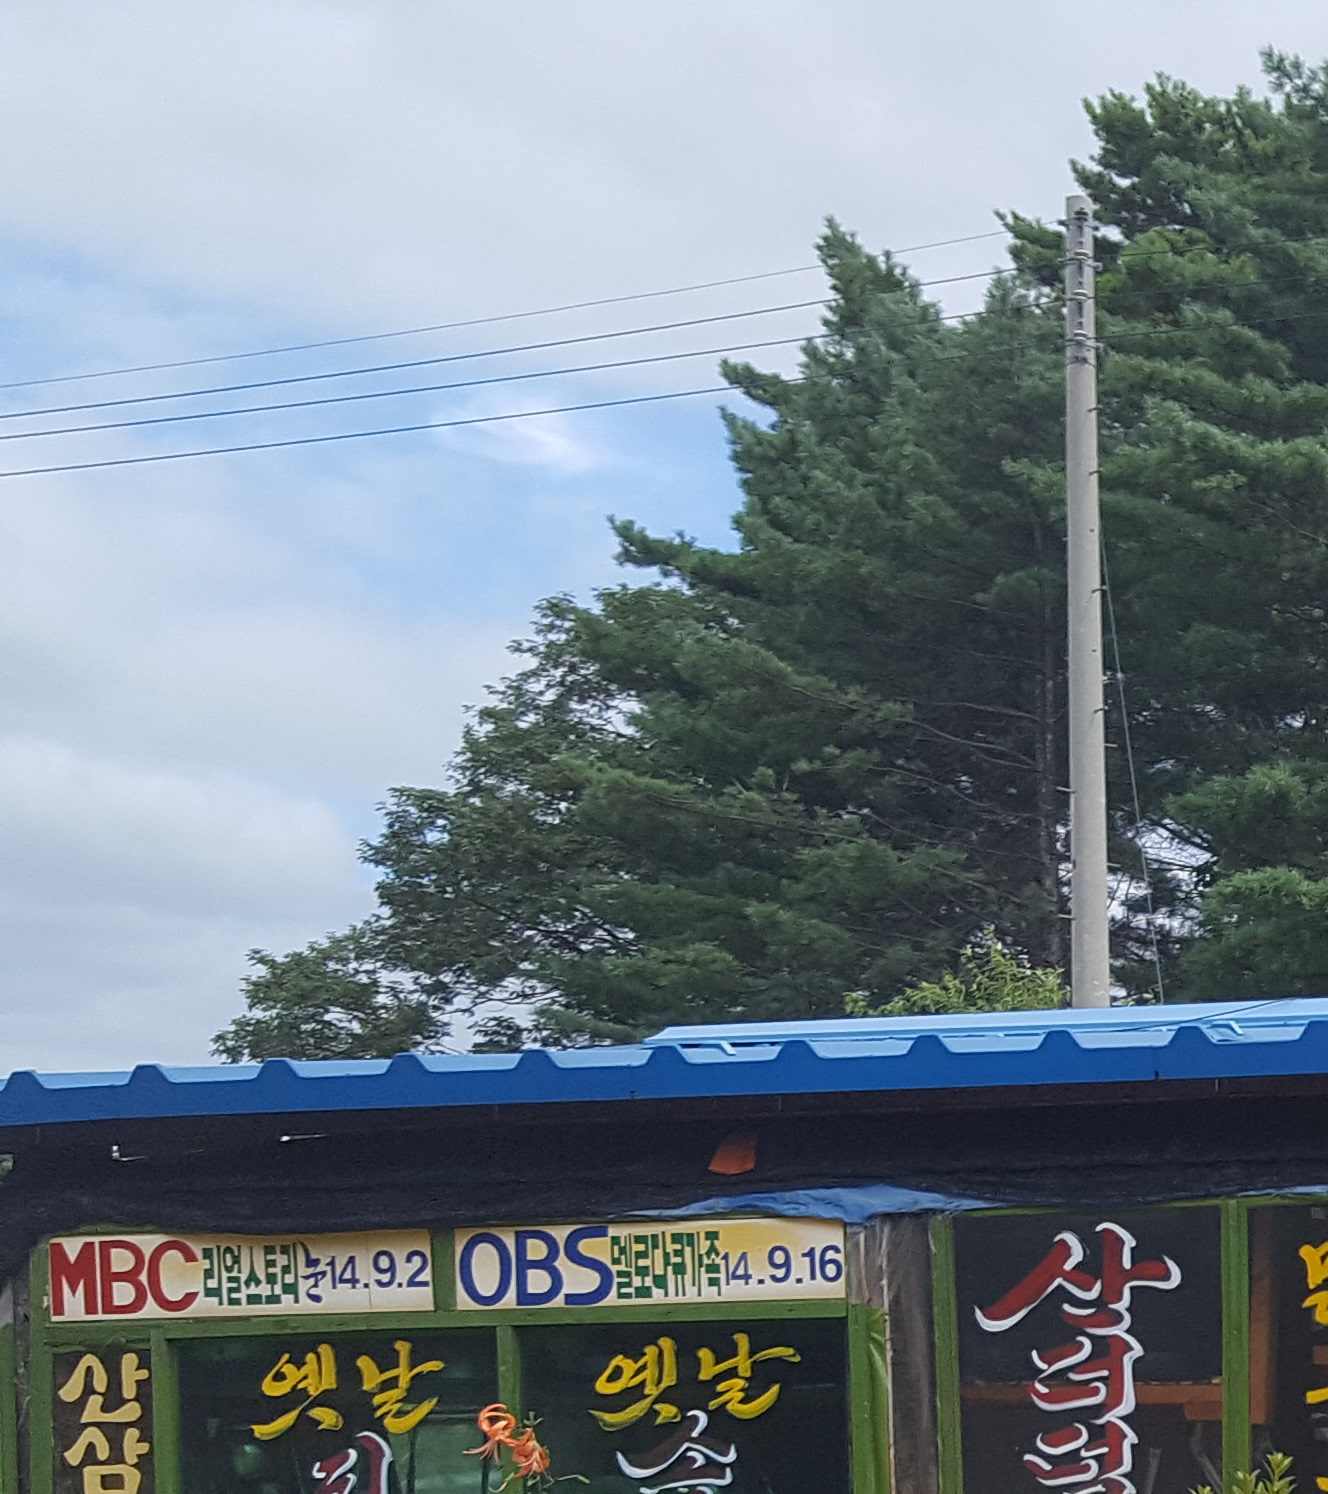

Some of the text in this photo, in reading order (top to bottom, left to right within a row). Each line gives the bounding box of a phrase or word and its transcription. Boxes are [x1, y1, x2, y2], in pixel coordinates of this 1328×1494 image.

[49, 1240, 200, 1317] MBC
[202, 1243, 299, 1306] 리얼스토리
[325, 1249, 431, 1290] 14.9.2
[459, 1226, 615, 1307] OBS
[721, 1244, 844, 1287] 14.9.16
[251, 1340, 446, 1440] 옛날
[588, 1333, 802, 1432] 옛날
